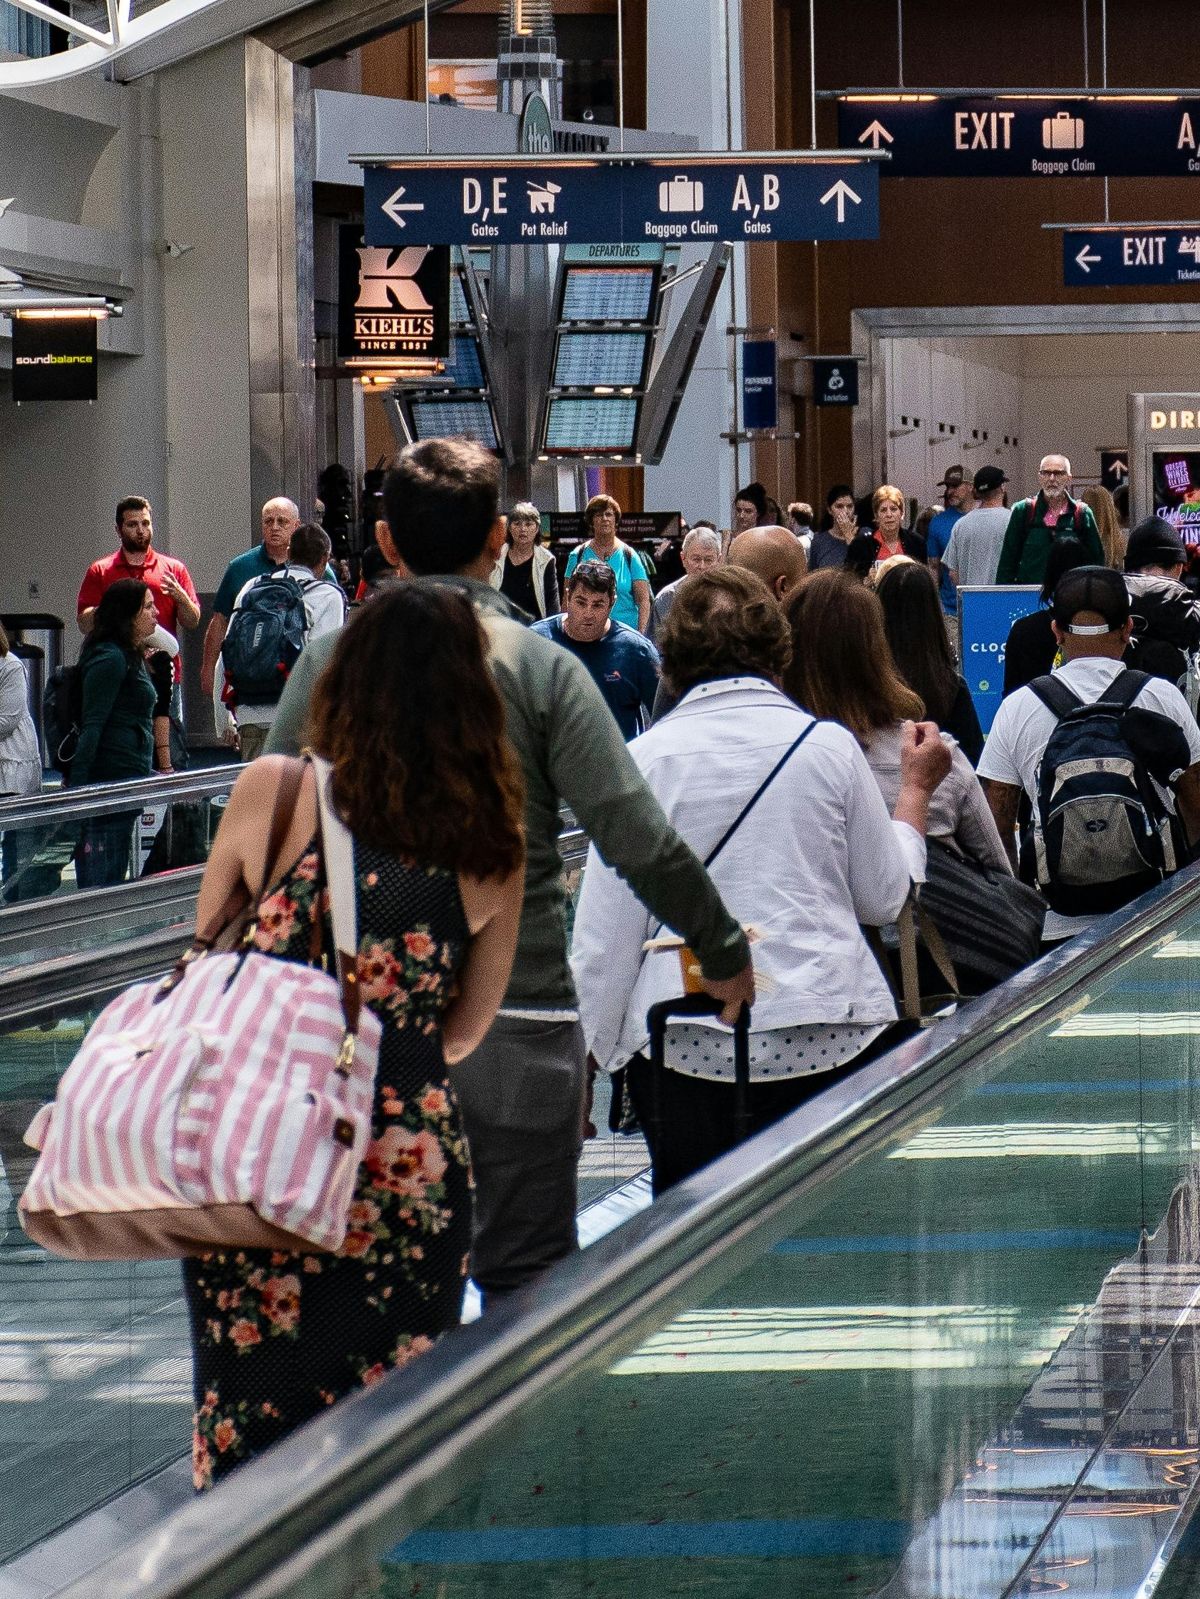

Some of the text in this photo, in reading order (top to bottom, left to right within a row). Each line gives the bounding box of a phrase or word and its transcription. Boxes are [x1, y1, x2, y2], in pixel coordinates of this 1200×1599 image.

[528, 122, 551, 152] the
[954, 111, 1015, 150] EXIT
[1031, 157, 1096, 174] Baggage Claim
[462, 173, 781, 222] D,E A,B
[471, 219, 772, 238] Gates Pet Relief Baggage Claim Gates
[588, 244, 641, 258] DEPARTURES
[1122, 236, 1167, 266] EXIT
[354, 246, 434, 311] K
[354, 318, 434, 335] KIEHL'S
[360, 341, 427, 350] SINCE 1851
[16, 353, 93, 365] soundbalance
